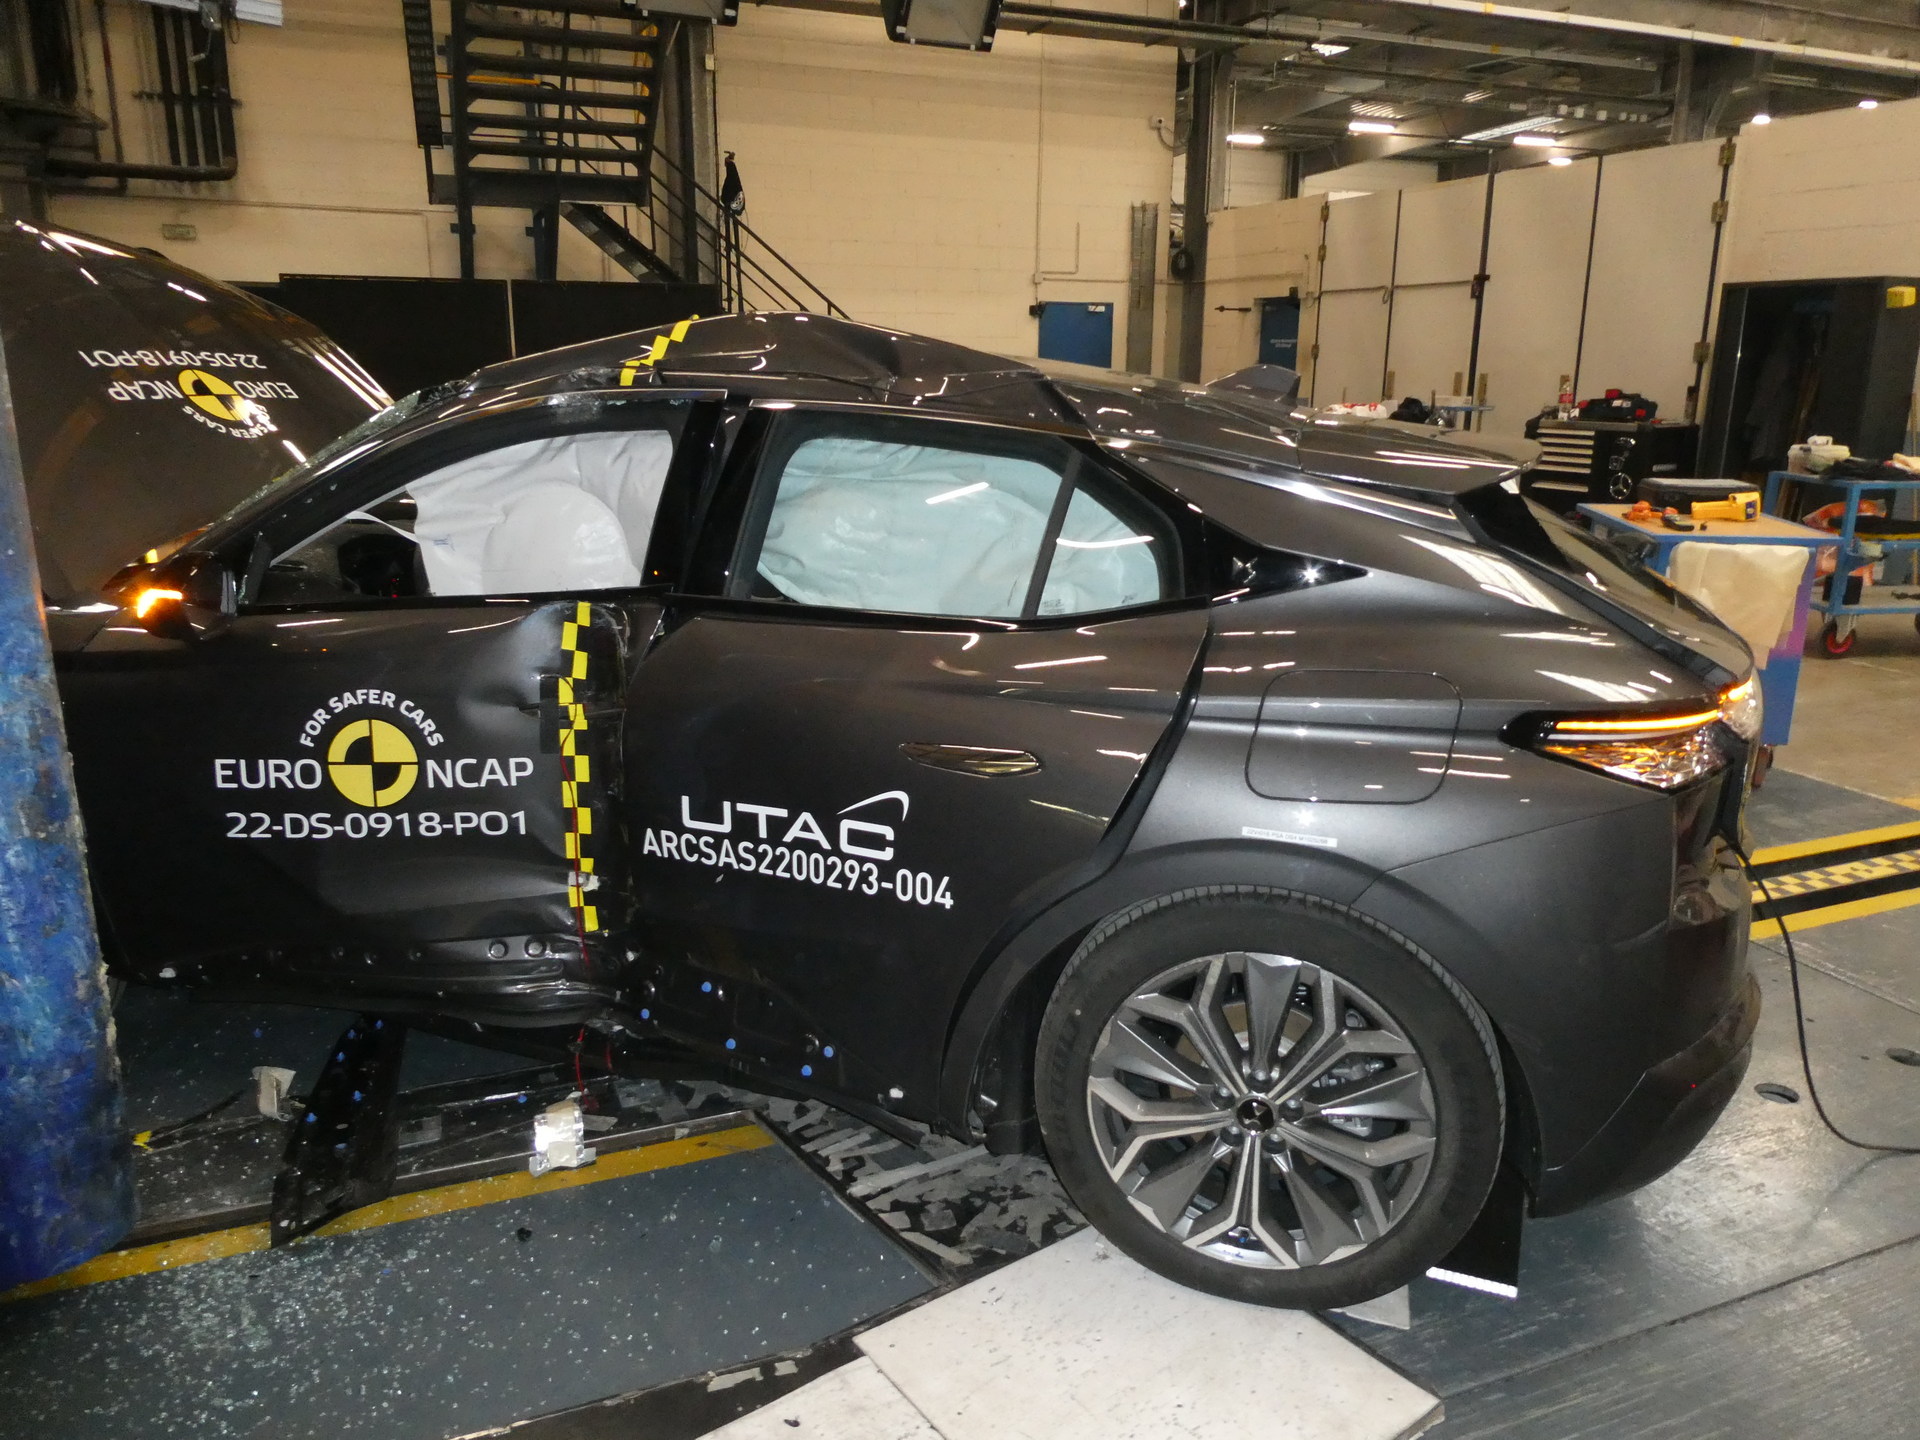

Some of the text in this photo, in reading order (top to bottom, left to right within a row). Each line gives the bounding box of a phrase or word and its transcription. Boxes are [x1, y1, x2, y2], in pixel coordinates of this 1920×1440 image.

[107, 380, 299, 401] EURO NCAP
[181, 405, 227, 434] CARS
[229, 423, 269, 439] SAFER
[300, 689, 444, 747] FOR SAFER CARS
[214, 756, 535, 789] EURO NCAP
[681, 795, 895, 861] UTAC
[643, 827, 954, 910] ARCSAS2200293-004
